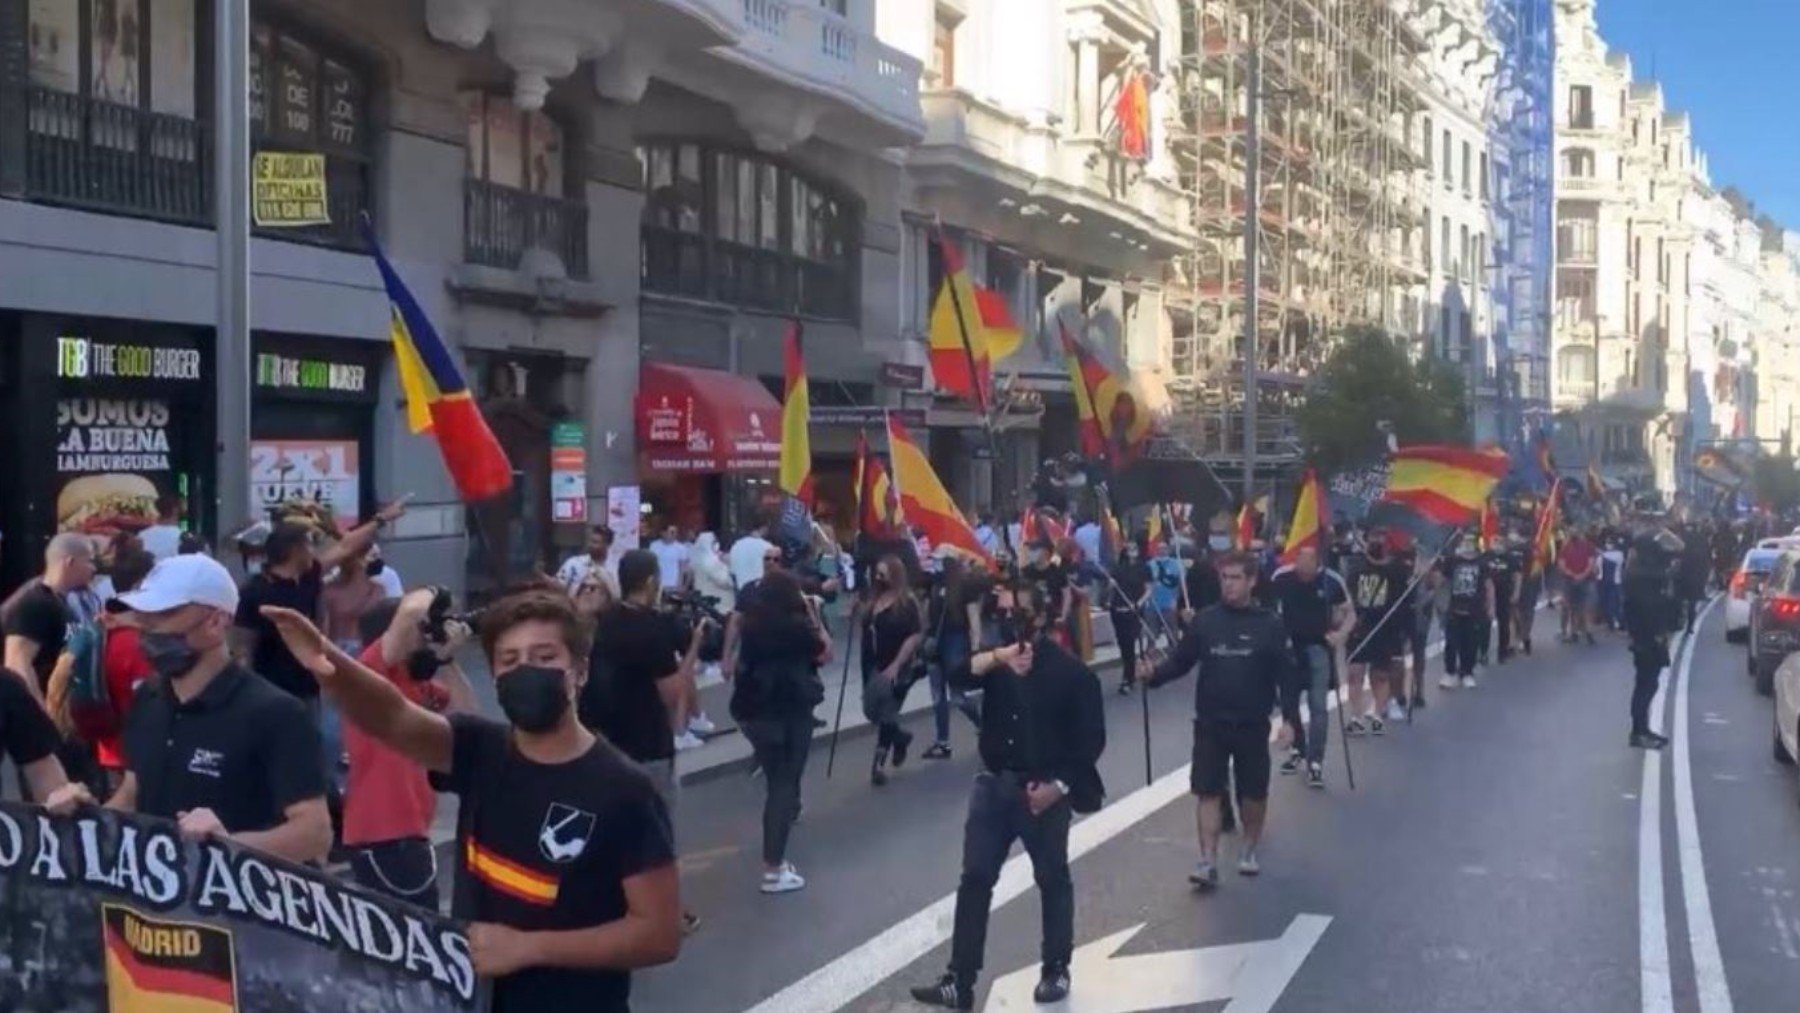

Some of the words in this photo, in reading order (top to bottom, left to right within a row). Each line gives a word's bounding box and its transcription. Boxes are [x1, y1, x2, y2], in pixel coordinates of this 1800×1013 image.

[57, 337, 88, 378] TGB
[93, 343, 116, 376] THE
[117, 344, 151, 377] GOOD
[153, 346, 199, 379] BURGER
[88, 427, 170, 452] BUENA
[30, 815, 67, 879] A
[77, 819, 180, 901] LAS
[198, 846, 475, 999] AGENDAS
[124, 914, 202, 956] MADRID
